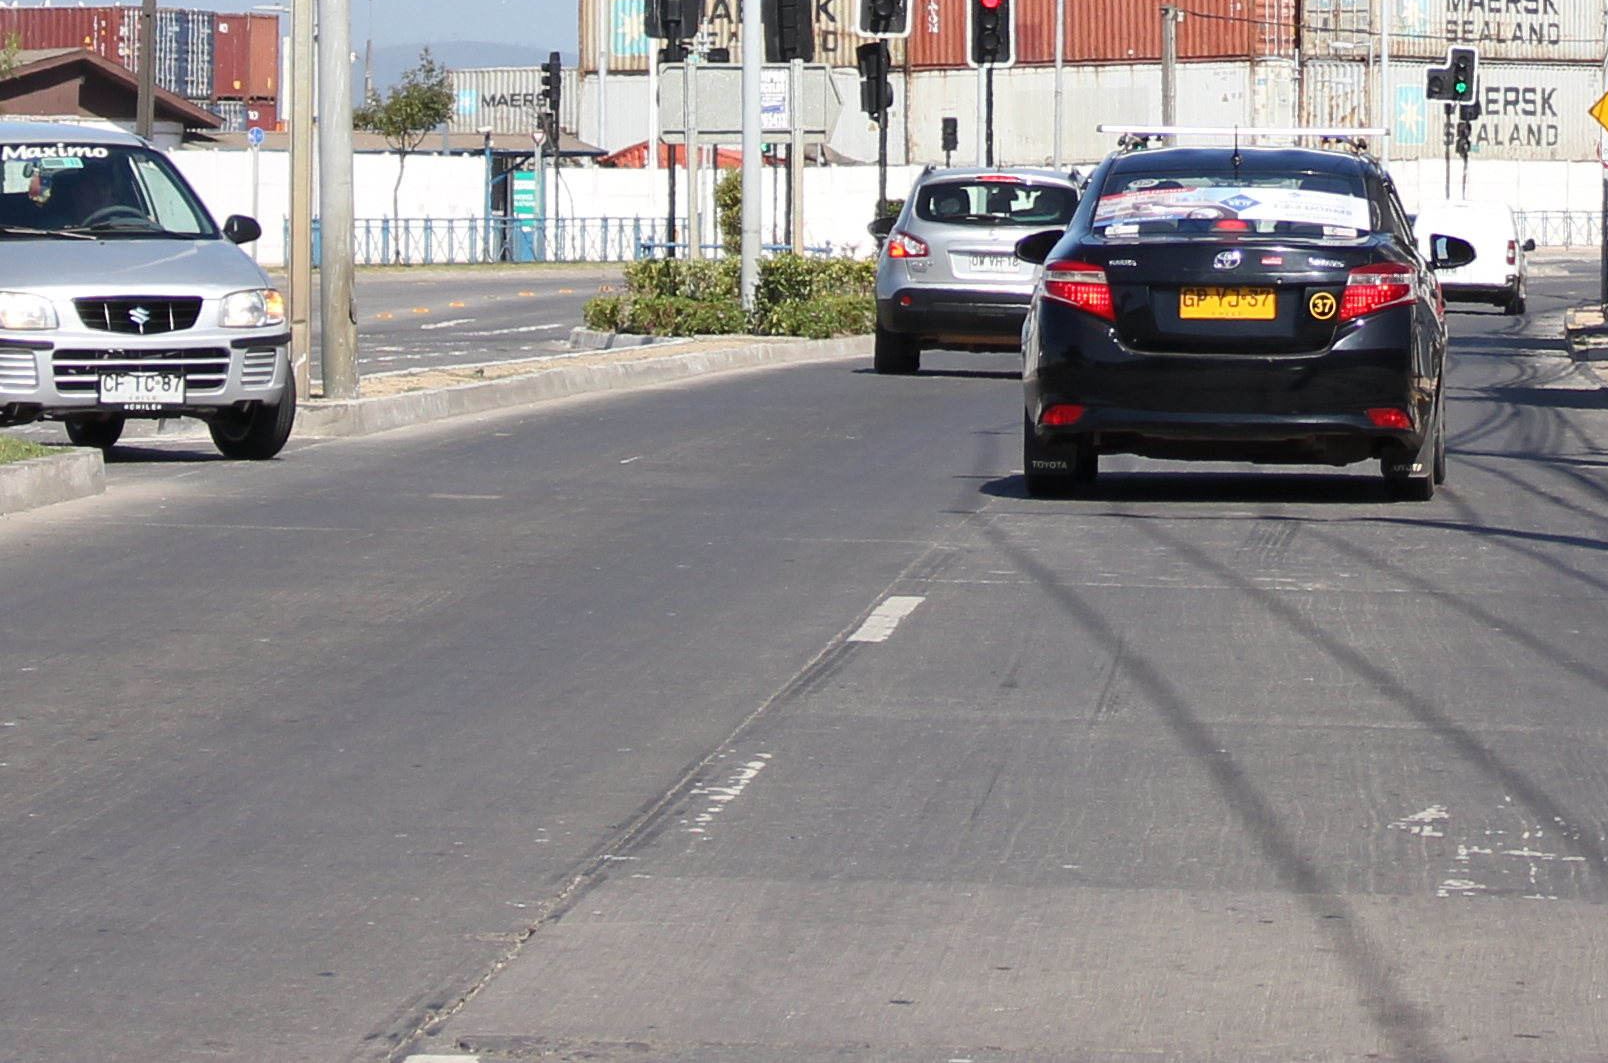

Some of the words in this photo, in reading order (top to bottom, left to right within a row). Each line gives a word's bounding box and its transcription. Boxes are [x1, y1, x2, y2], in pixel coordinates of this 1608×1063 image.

[1446, 20, 1560, 45] SEALAND
[481, 93, 550, 108] MAERS
[1465, 87, 1558, 117] ERSK
[1444, 122, 1559, 147] SALAND
[2, 142, 109, 161] Maximo
[1314, 299, 1331, 313] 37
[1032, 460, 1068, 469] TOYOTA
